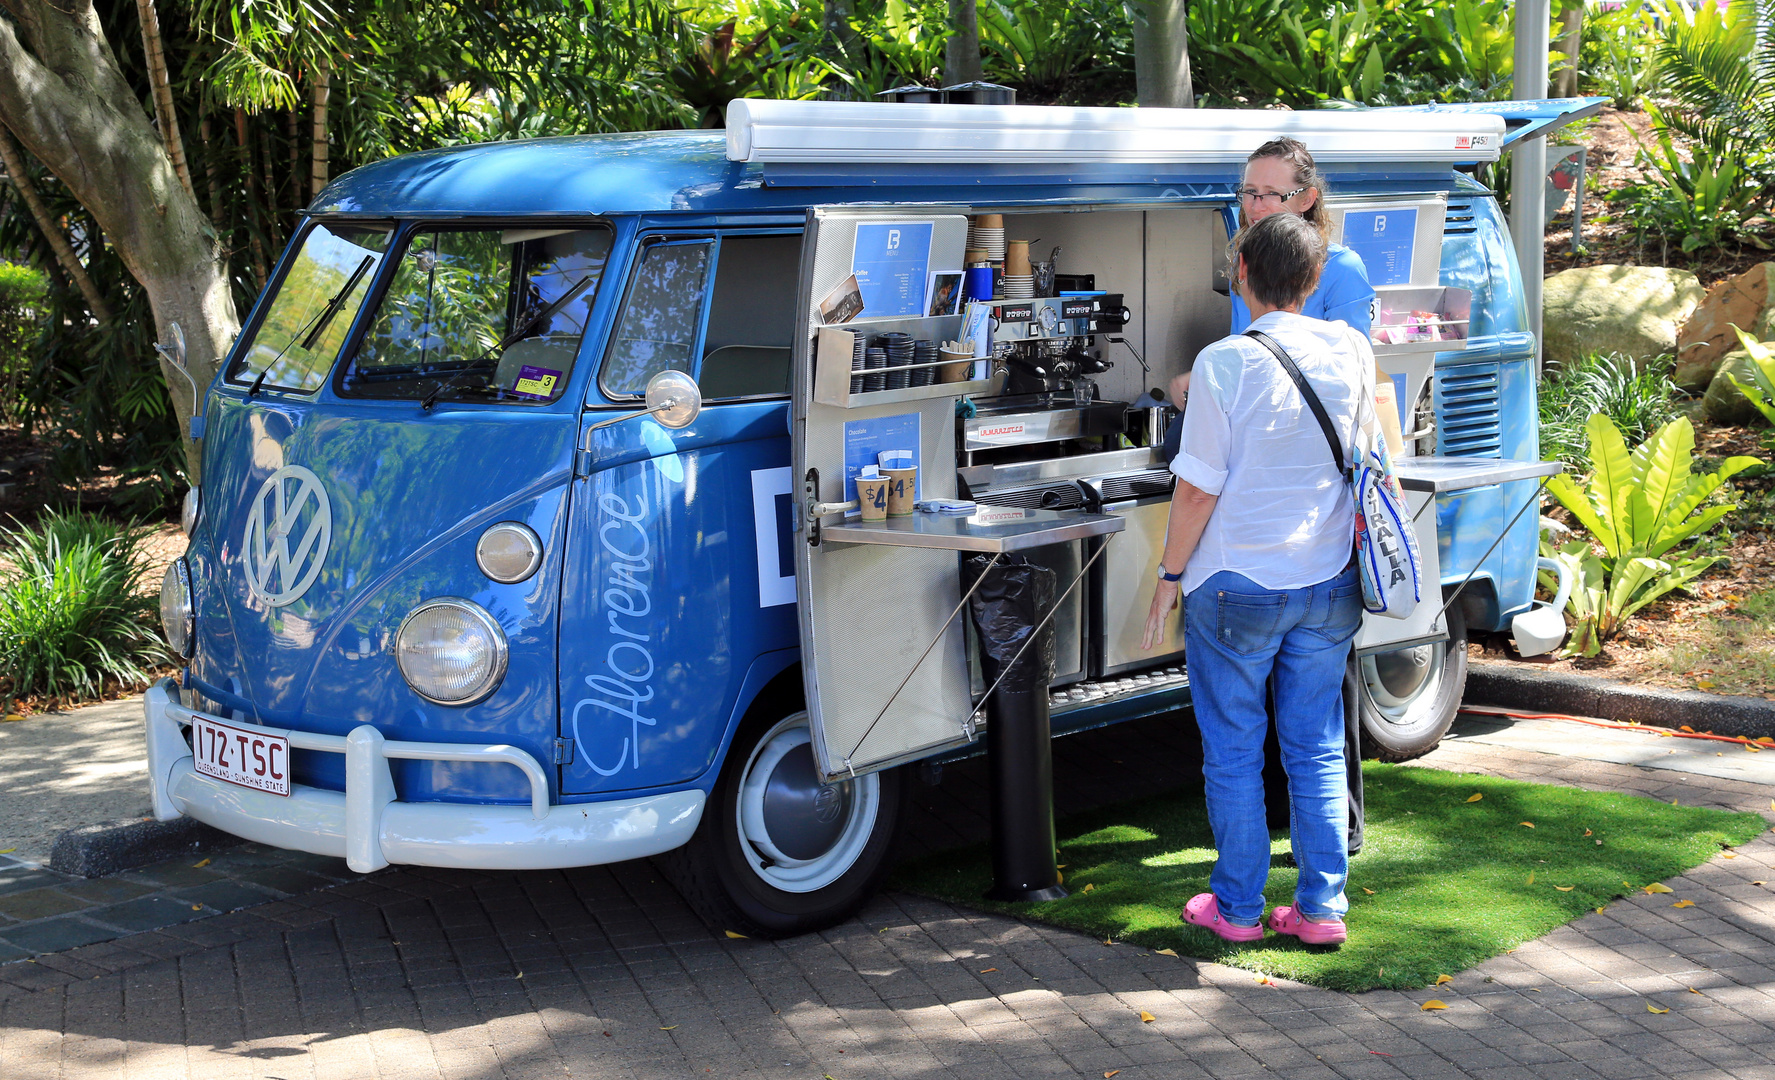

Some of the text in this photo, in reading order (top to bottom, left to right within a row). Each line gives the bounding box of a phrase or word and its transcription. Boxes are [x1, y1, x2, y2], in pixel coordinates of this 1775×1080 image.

[543, 377, 552, 386] 3
[848, 428, 867, 436] Chocolate
[866, 484, 886, 512] $4
[1367, 469, 1406, 589] STRALIA
[572, 493, 657, 777] Florence
[199, 762, 230, 778] QUEENSLAND
[234, 773, 263, 788] SUNSHINE
[265, 781, 284, 792] STATE
